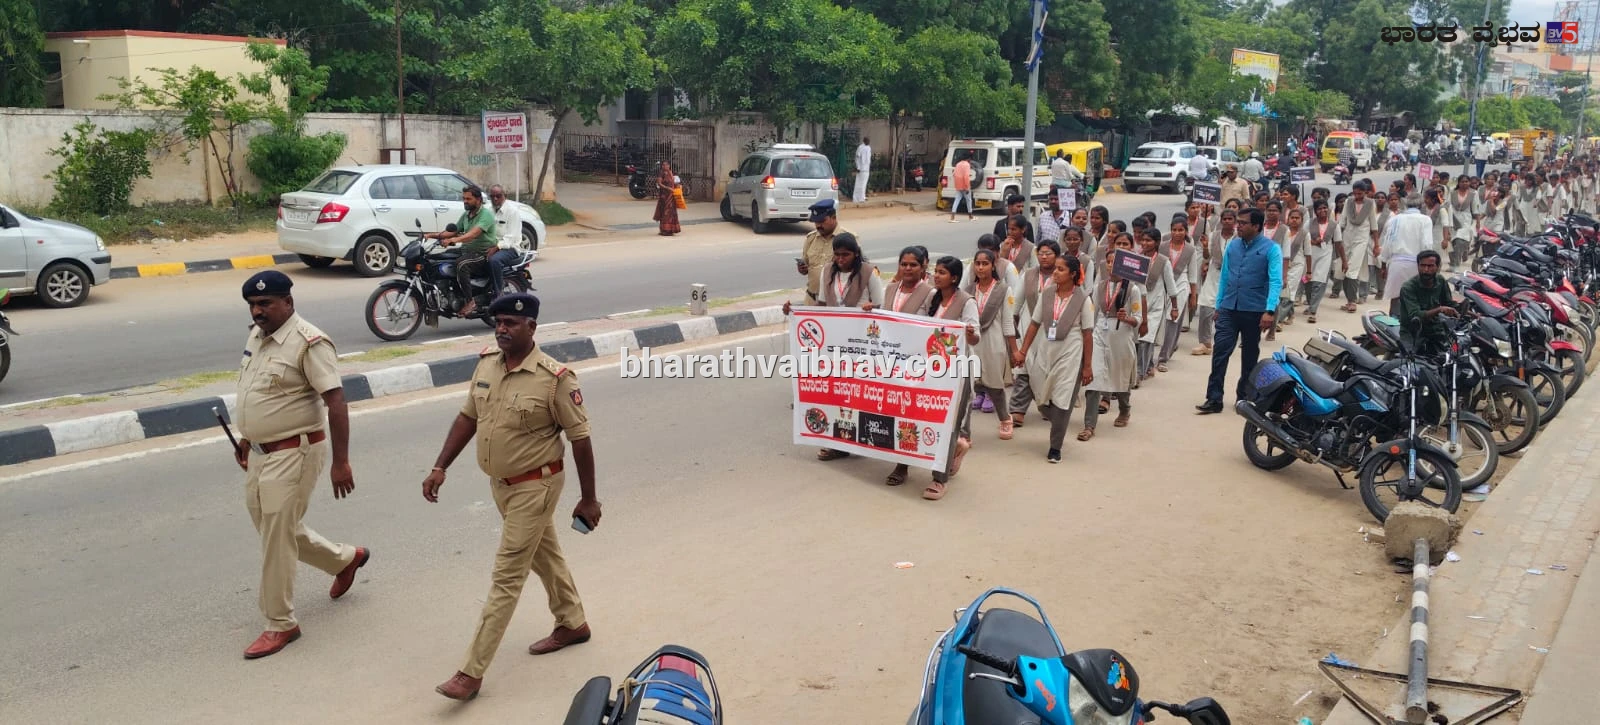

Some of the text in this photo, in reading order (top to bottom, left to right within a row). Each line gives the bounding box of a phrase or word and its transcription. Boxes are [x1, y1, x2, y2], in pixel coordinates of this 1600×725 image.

[487, 135, 523, 143] POLICE STATION
[692, 290, 699, 301] 6
[701, 290, 707, 303] 6
[799, 379, 830, 394] ಮಾದಕ
